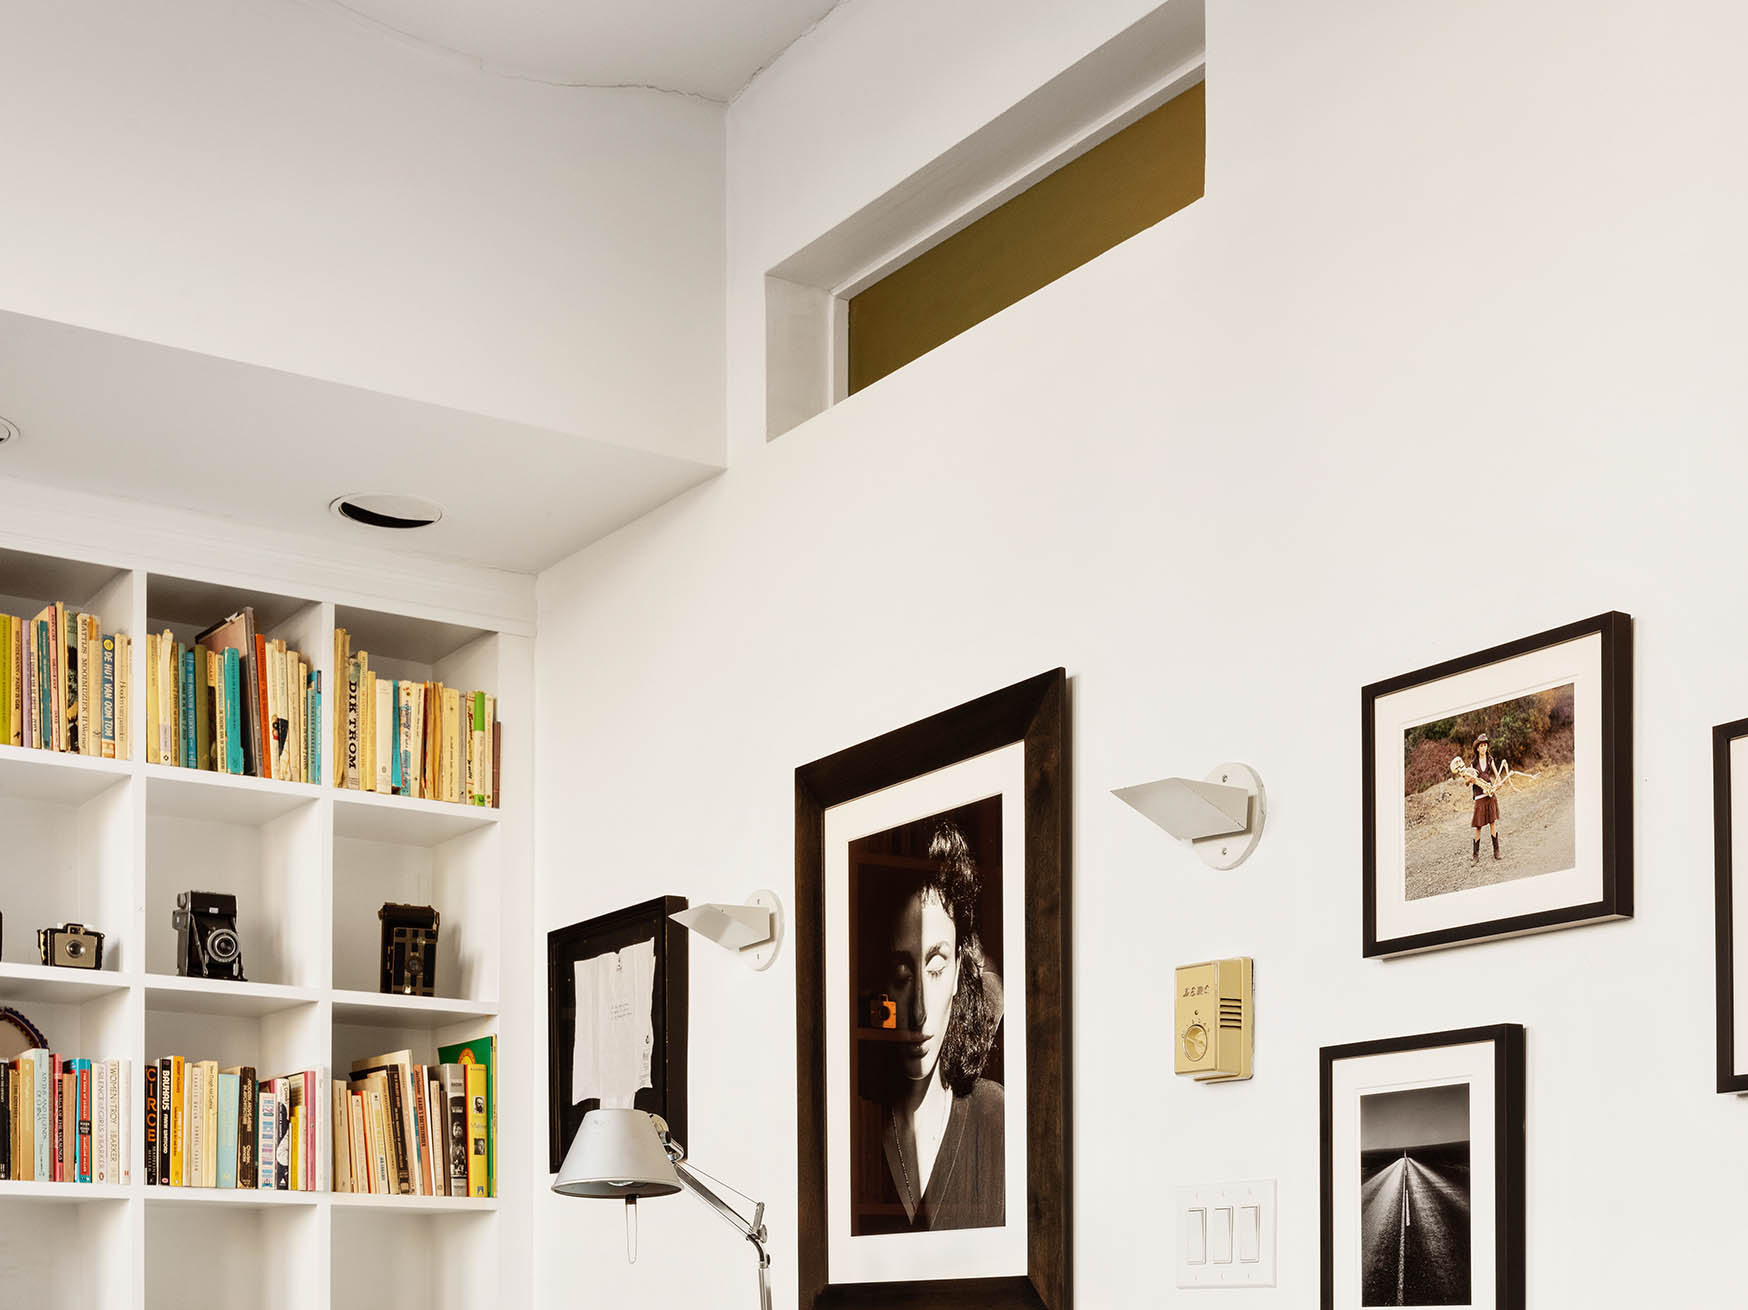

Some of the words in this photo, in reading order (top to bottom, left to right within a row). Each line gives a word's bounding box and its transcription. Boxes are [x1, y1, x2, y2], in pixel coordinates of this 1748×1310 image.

[104, 651, 113, 662] DE
[104, 664, 112, 680] HUT
[104, 683, 112, 698] VAN
[147, 1068, 157, 1142] CIRCE
